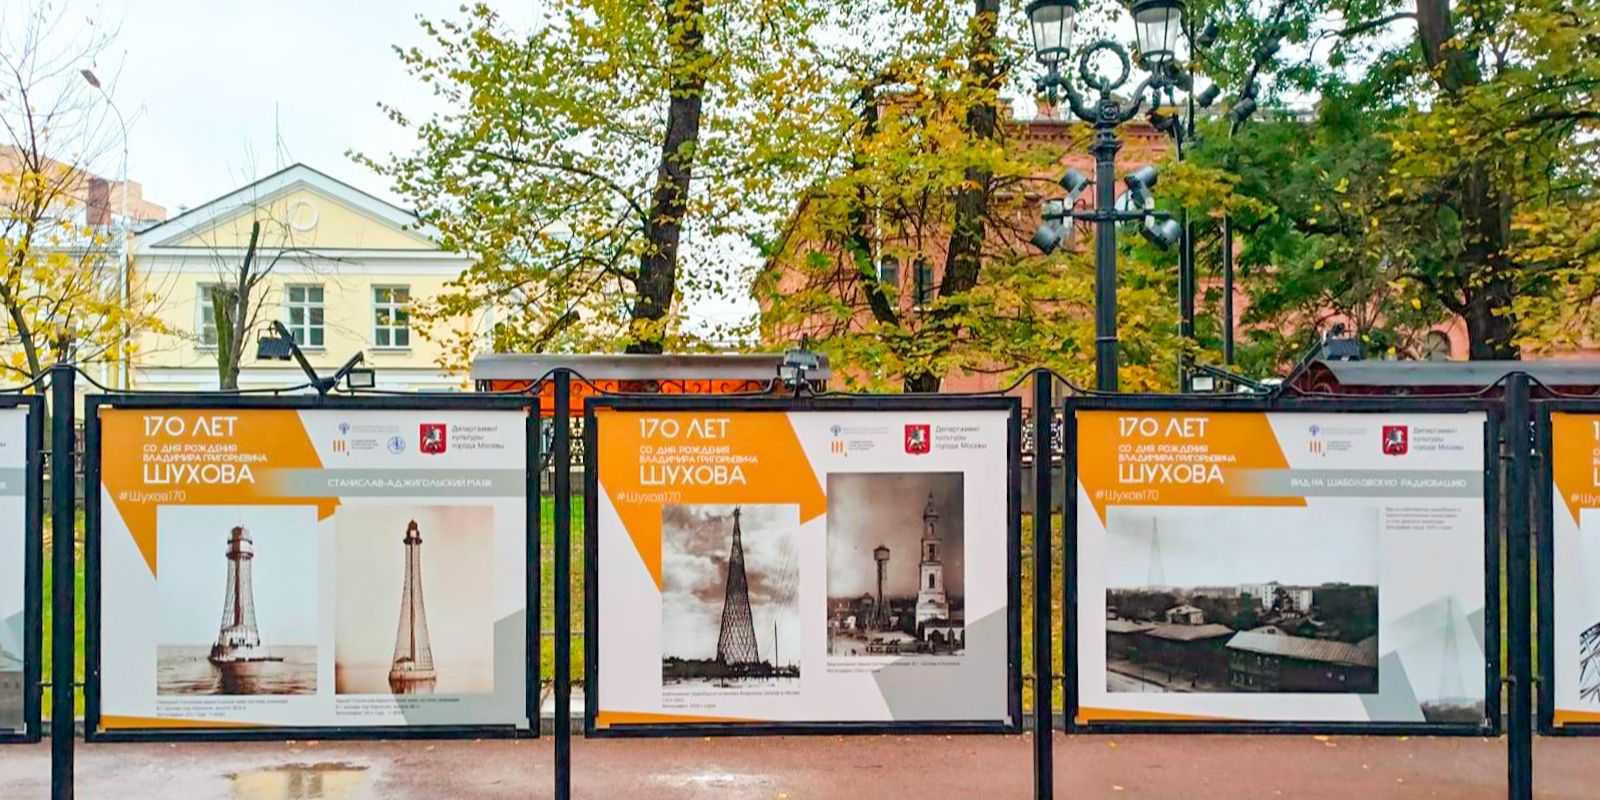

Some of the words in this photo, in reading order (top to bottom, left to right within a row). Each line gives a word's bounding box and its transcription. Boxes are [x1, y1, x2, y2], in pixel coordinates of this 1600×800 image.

[143, 416, 185, 437] 170
[192, 416, 238, 437] ЛЕТ
[452, 424, 498, 434] Департамент
[639, 418, 680, 439] 170
[686, 418, 731, 439] ЛЕТ
[1118, 417, 1159, 438] 170
[1165, 417, 1209, 438] ЛЕТ
[143, 444, 157, 453] СО
[161, 444, 181, 453] ДНЯ
[184, 444, 237, 453] РОЖДЕНИЯ
[477, 442, 505, 450] Москвы
[639, 446, 653, 454] СО
[657, 446, 676, 455] ДНЯ
[679, 446, 730, 455] РОЖДЕНИЯ
[1118, 445, 1132, 453] СО
[1135, 445, 1155, 453] ДНЯ
[1158, 445, 1209, 453] РОЖДЕНИЯ
[143, 453, 201, 463] ВЛАДИМИРА
[202, 453, 268, 463] ГРИГОРЬЕВИЧА
[639, 455, 695, 464] ВЛАДИМИРА
[697, 455, 759, 464] ГРИГОРЬЕВИЧА
[1118, 454, 1174, 463] ВЛАДИМИРА
[1175, 454, 1237, 463] ГРИГОРЬЕВИЧА
[143, 464, 255, 484] ШУХОВА
[639, 465, 747, 486] ШУХОВА
[1118, 464, 1225, 484] ШУХОВА
[467, 478, 493, 488] МАЯК
[1290, 479, 1311, 488] ВИД
[1312, 479, 1325, 488] НА
[1327, 479, 1398, 488] ШАБОЛОВСКУЮ
[119, 490, 187, 504] #Шухов170
[616, 492, 681, 505] #Шухов170
[1095, 490, 1160, 503] #Шухов170
